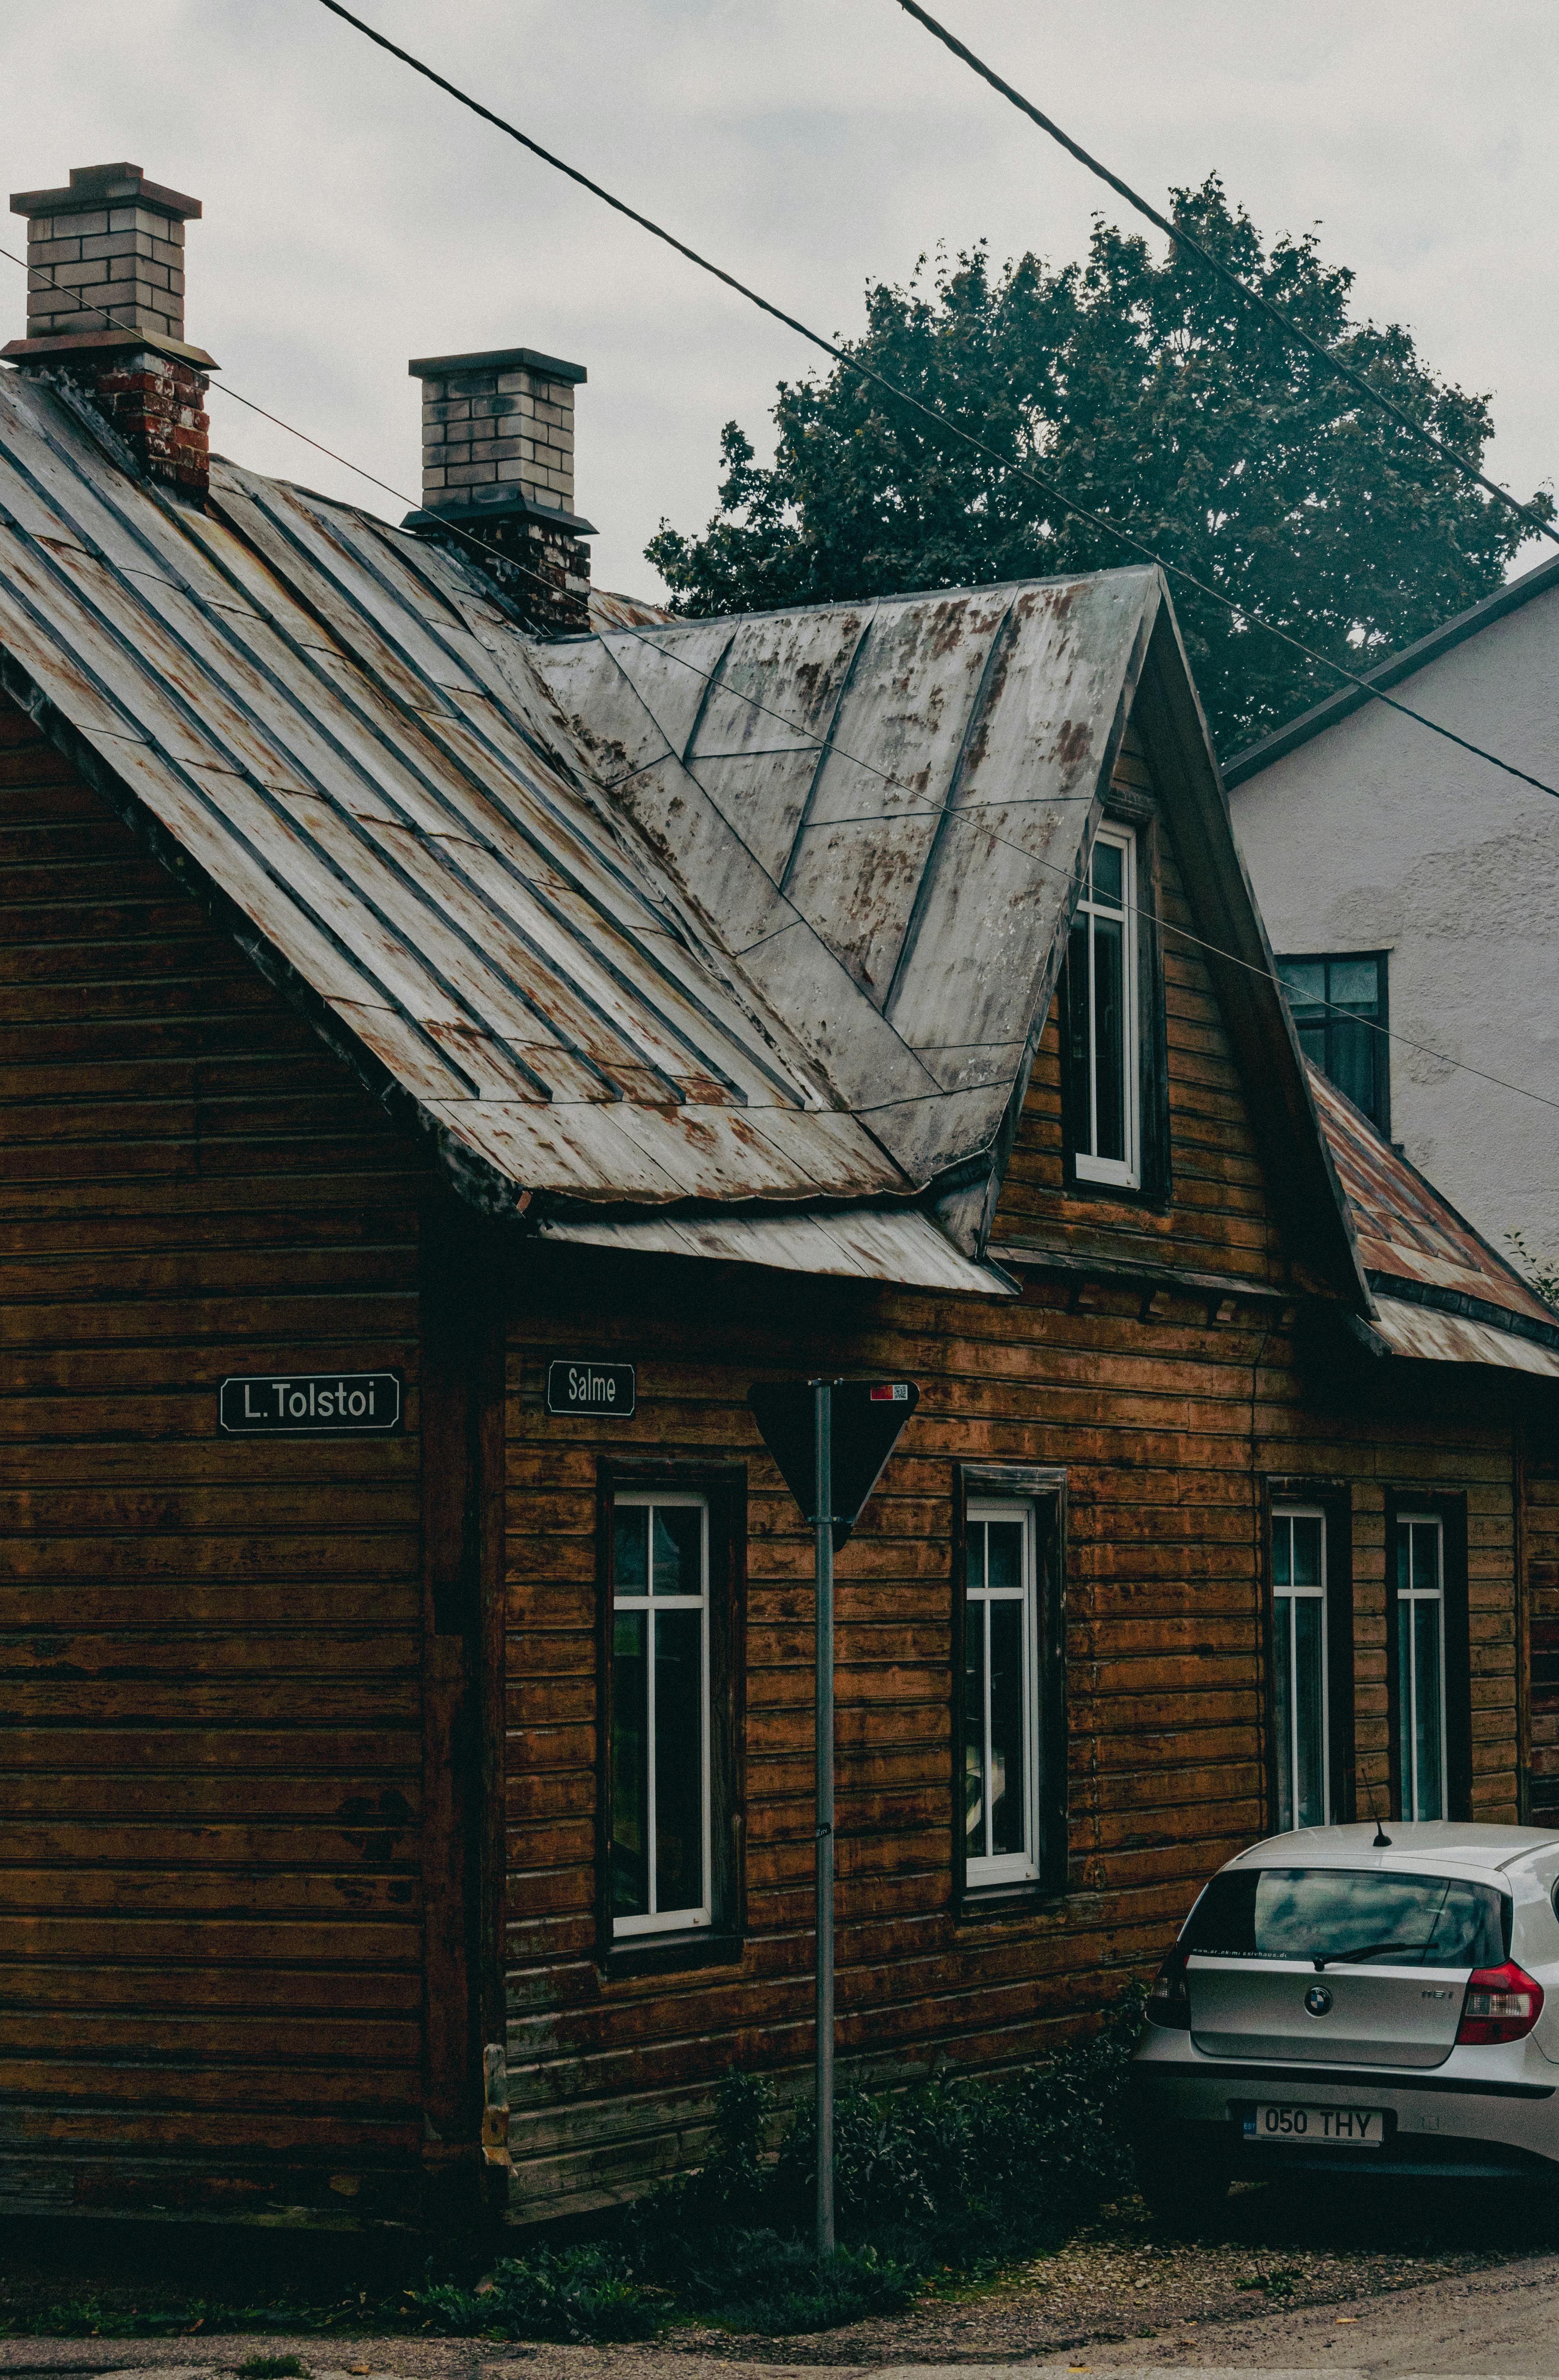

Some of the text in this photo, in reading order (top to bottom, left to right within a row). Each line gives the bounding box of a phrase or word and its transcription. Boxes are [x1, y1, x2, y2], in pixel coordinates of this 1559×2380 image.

[569, 1368, 615, 1402] Salme
[1265, 2108, 1372, 2137] 050 THY
